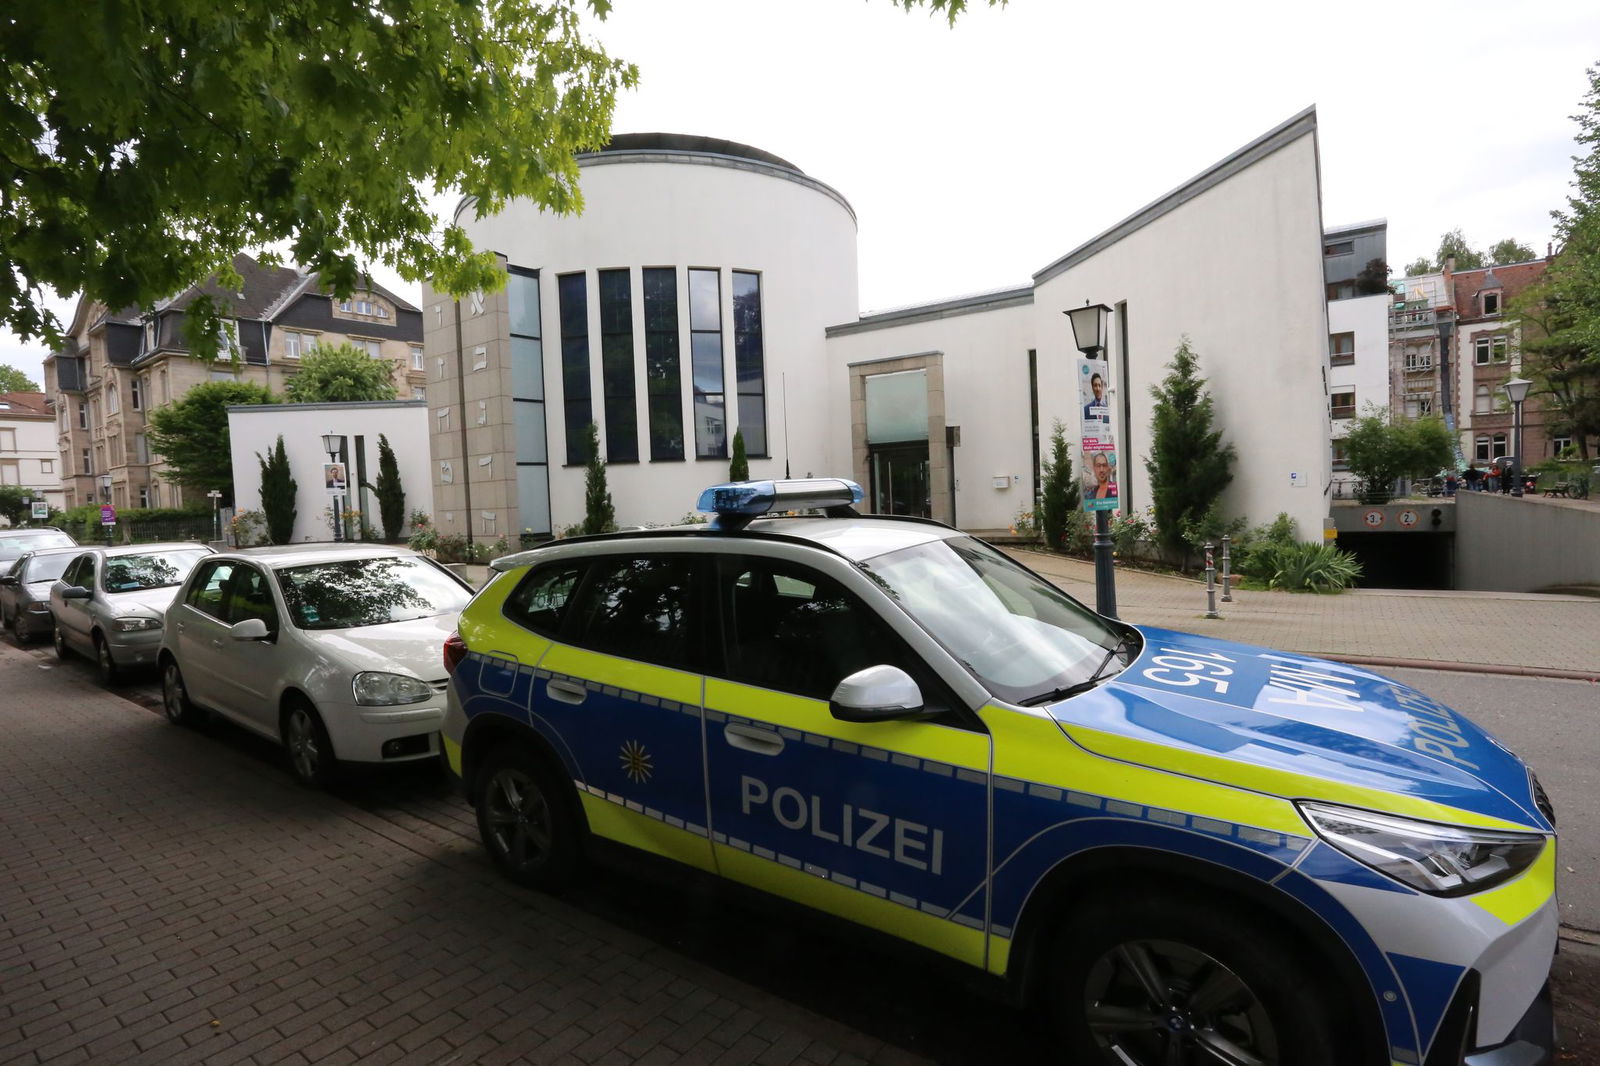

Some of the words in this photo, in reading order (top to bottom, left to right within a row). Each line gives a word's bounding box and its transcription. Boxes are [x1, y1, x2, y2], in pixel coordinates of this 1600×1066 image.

[1143, 647, 1237, 694] 165
[1268, 664, 1364, 712] MA
[742, 775, 944, 876] POLIZEI
